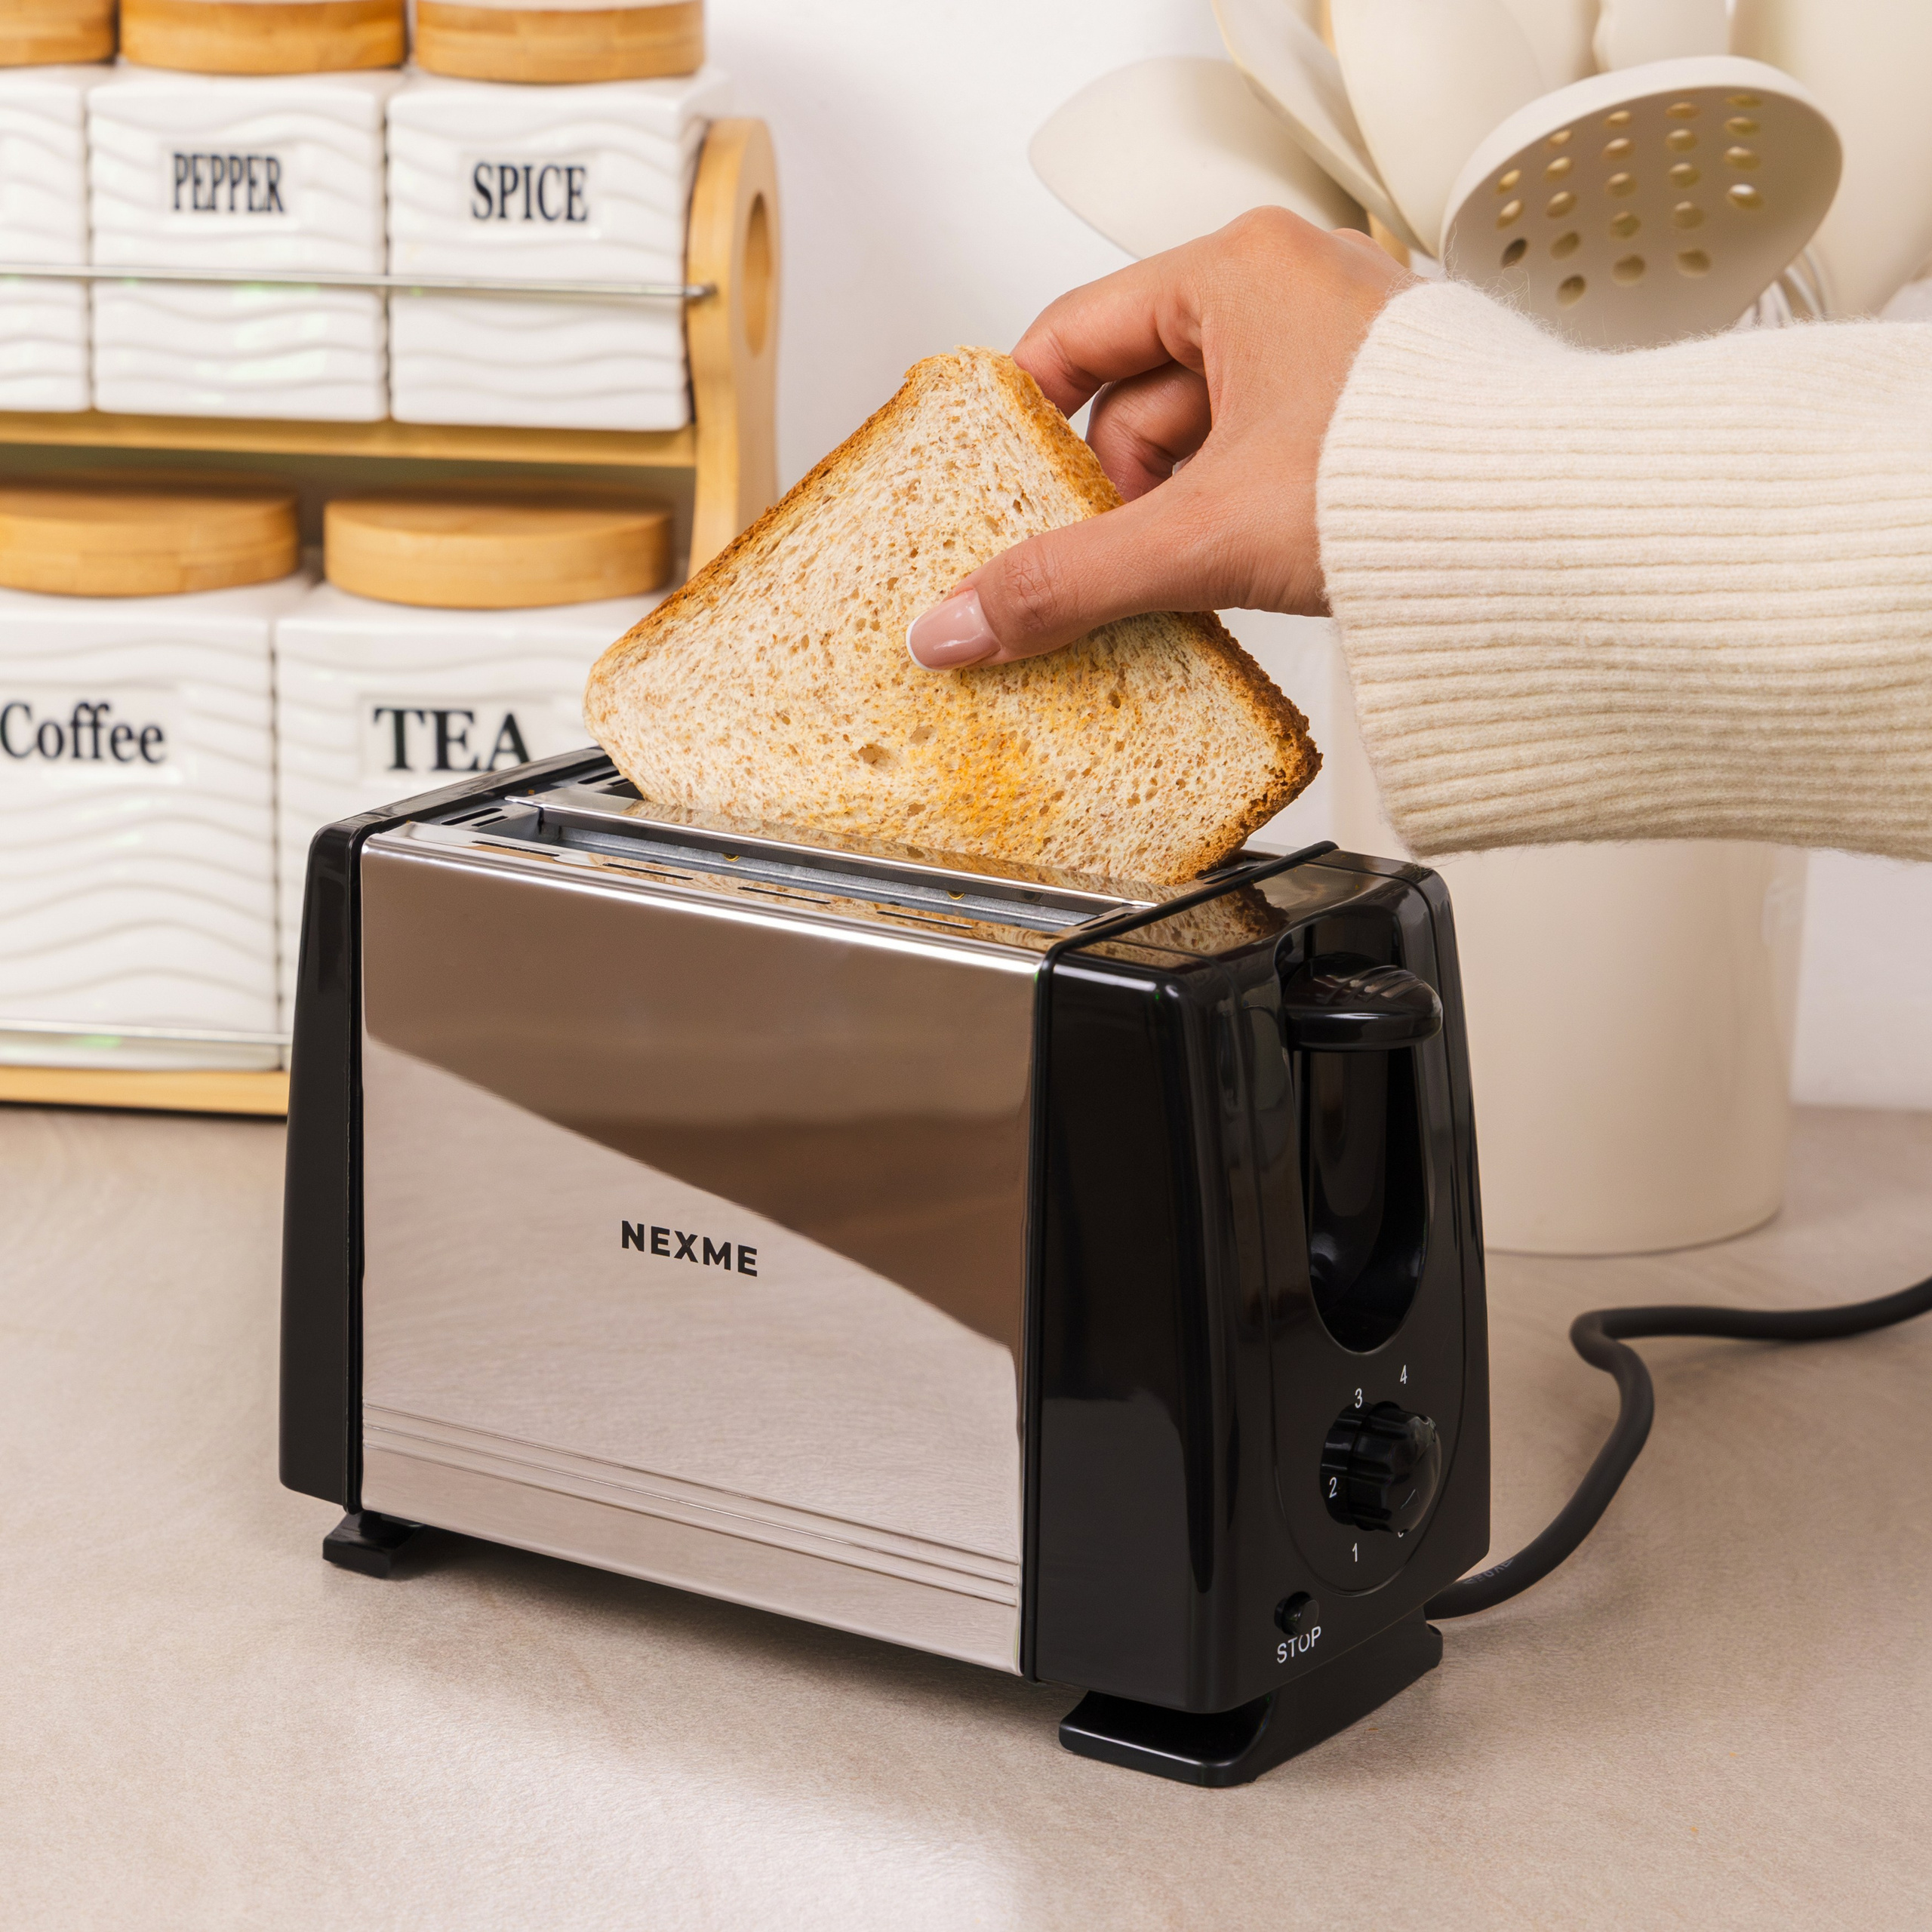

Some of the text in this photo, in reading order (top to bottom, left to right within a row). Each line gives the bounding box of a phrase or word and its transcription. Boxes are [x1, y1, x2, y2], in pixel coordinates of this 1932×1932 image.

[173, 152, 285, 214] PEPPER
[472, 162, 587, 223] SPICE
[0, 702, 166, 764] Coffee
[374, 708, 531, 771] TEA
[621, 1220, 758, 1277] NEXME
[1400, 1364, 1407, 1384] 4
[1355, 1388, 1363, 1409] 3
[1328, 1477, 1338, 1499] 2
[1352, 1543, 1358, 1562] 1
[1277, 1626, 1321, 1664] STOP
